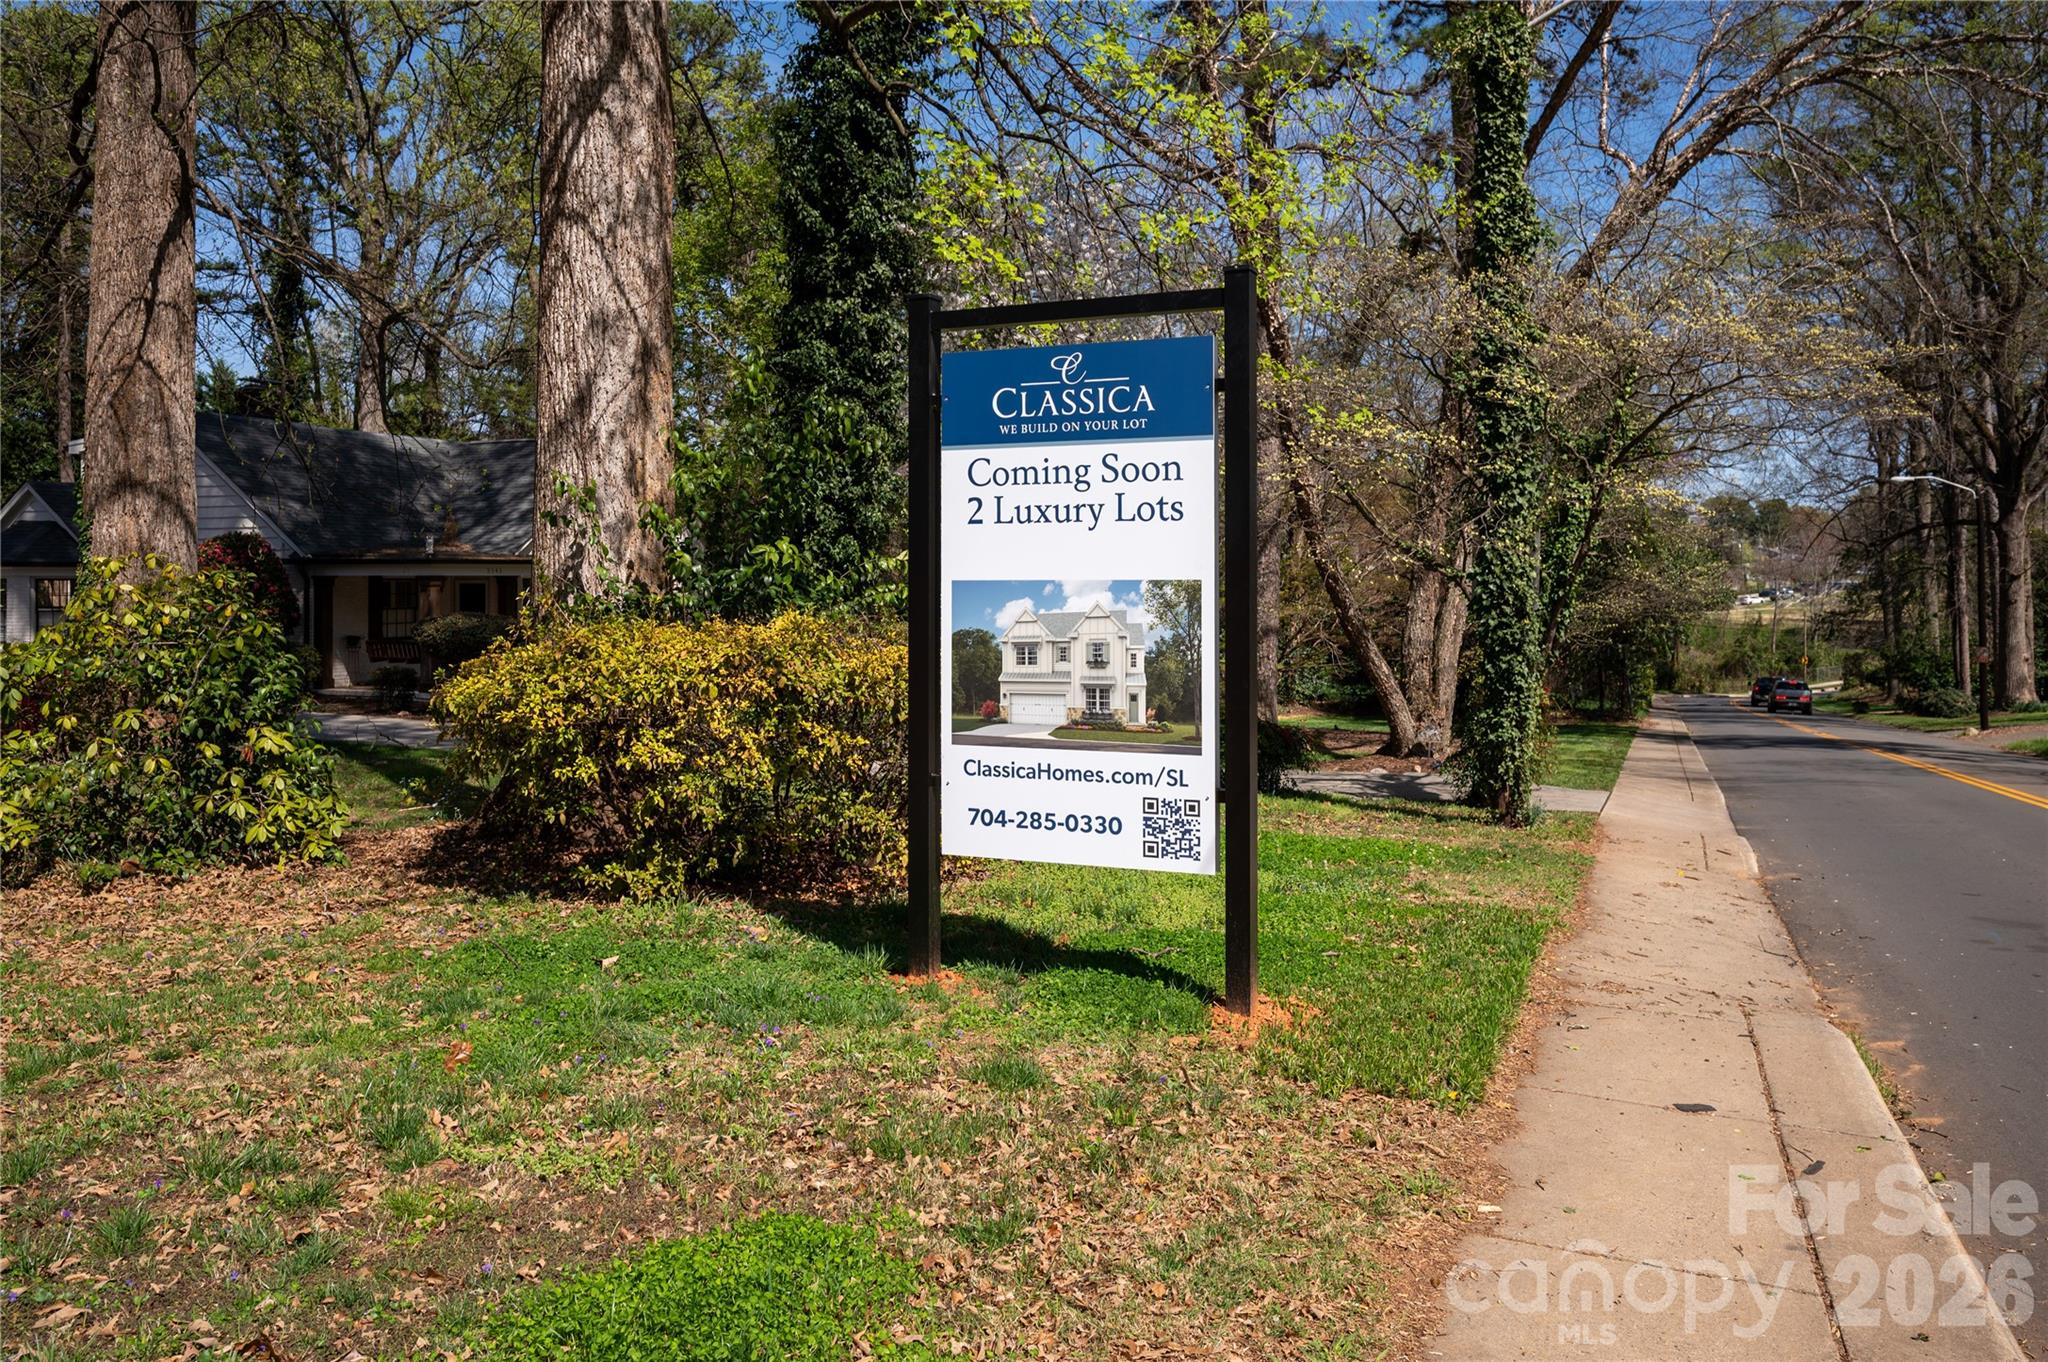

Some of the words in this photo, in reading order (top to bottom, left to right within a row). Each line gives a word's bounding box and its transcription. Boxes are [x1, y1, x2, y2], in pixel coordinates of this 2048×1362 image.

[991, 384, 1156, 419] CLASSICA
[1000, 424, 1018, 435] WE
[1021, 422, 1058, 434] BUILD
[1061, 421, 1080, 432] ON
[1084, 420, 1119, 431] YOUR
[1122, 418, 1148, 430] LOT
[967, 457, 1092, 493] Coming
[1101, 453, 1184, 484] Soon
[967, 496, 983, 525] 2
[994, 495, 1105, 531] Luxury
[1114, 492, 1184, 522] Lots
[963, 759, 1189, 788] ClassicaHomes.com/SL
[967, 807, 1123, 835] 704-285-0330
